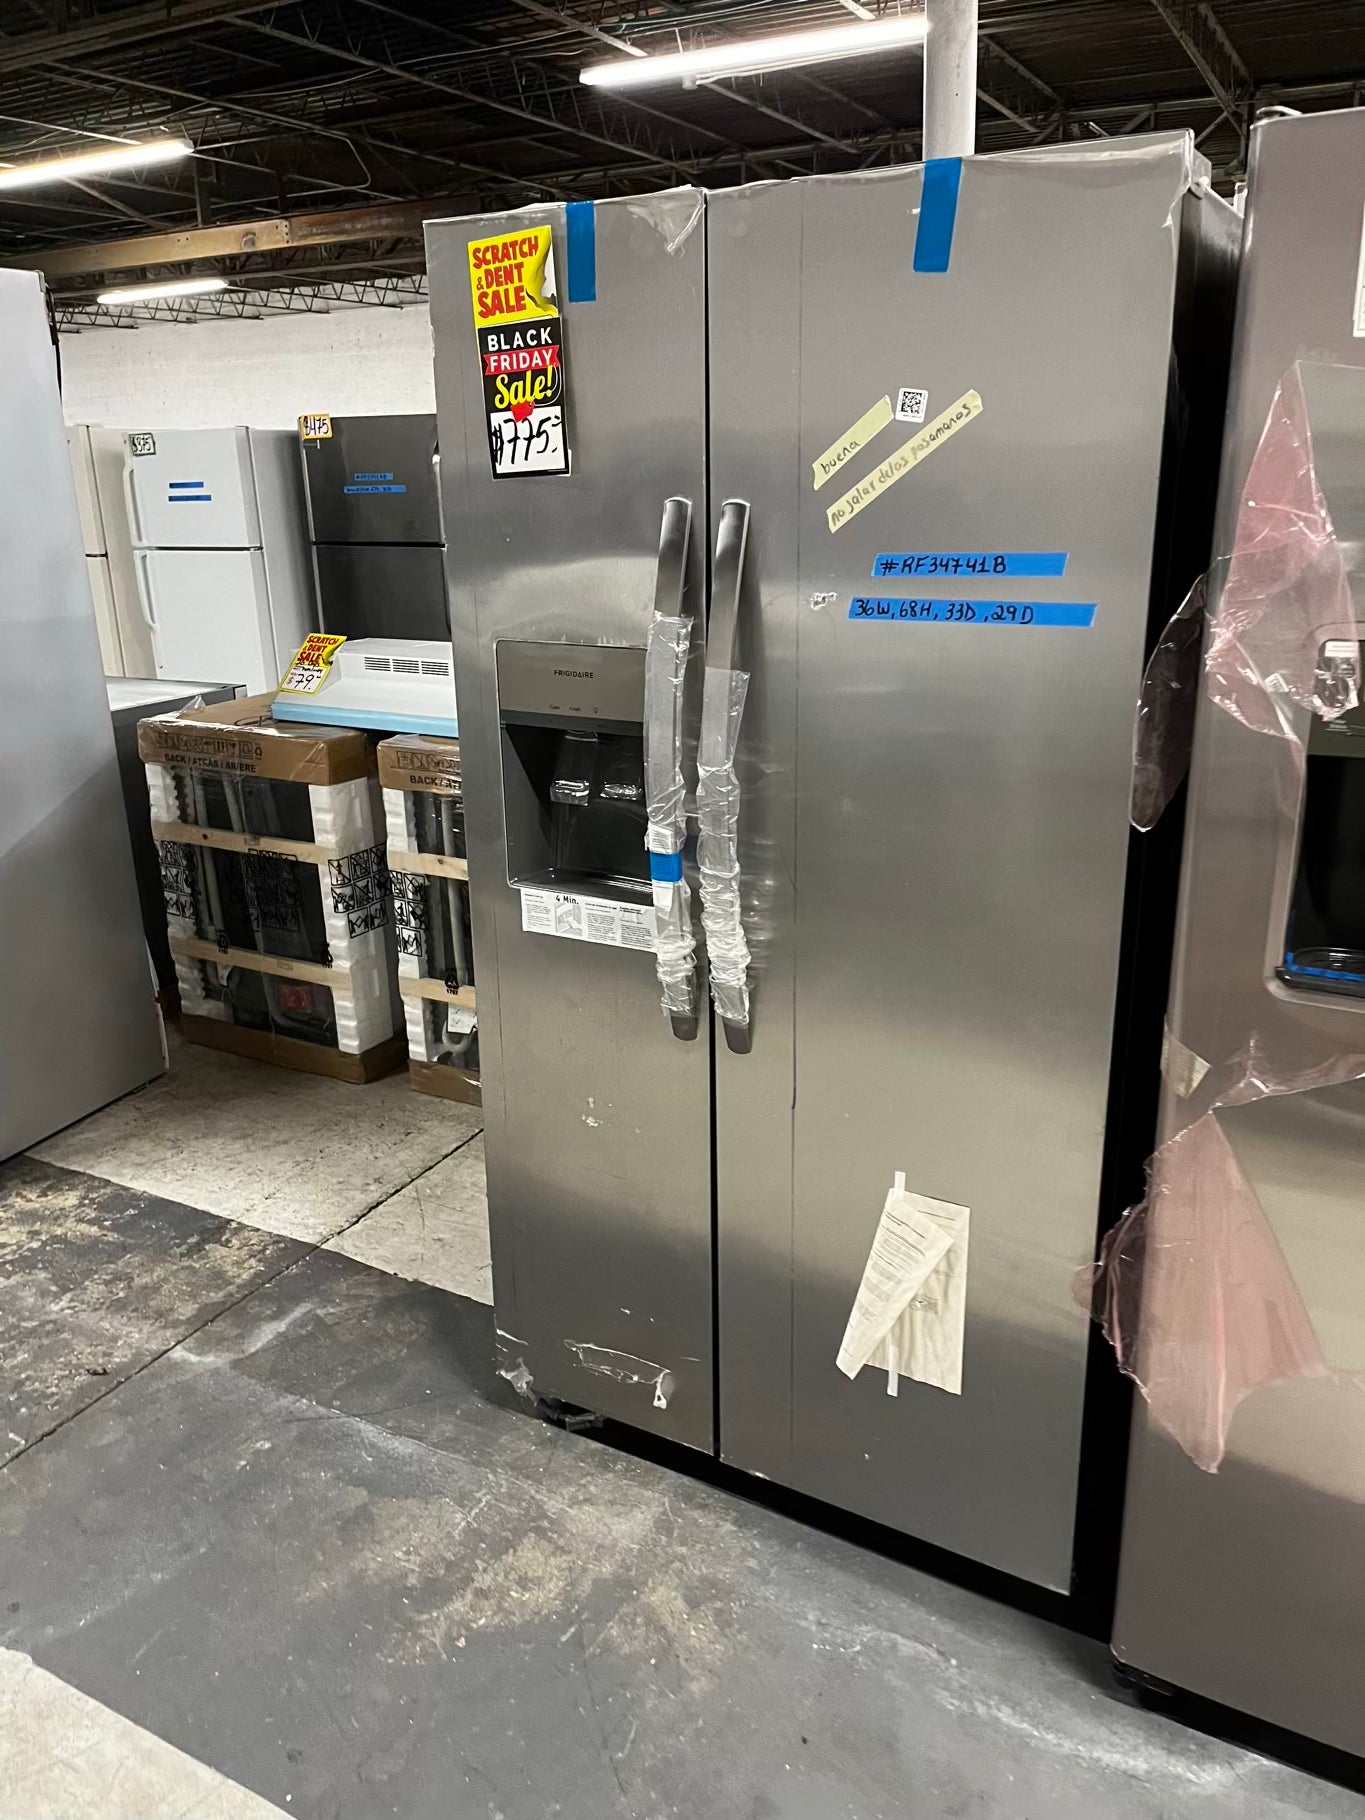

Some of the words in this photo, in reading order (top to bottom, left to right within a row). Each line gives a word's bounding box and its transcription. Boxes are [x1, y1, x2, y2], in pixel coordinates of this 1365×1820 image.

[472, 235, 539, 269] SCRATCH
[476, 276, 484, 291] &
[483, 261, 525, 290] DENT
[477, 284, 527, 319] SALE
[487, 326, 552, 352] BLACK
[489, 348, 553, 372] FRIDAY
[494, 364, 553, 409] Sale!
[303, 415, 329, 436] $475
[820, 440, 861, 475] buena
[831, 509, 846, 527] no
[307, 635, 339, 645] SCRATCH
[307, 644, 327, 652] DENT
[298, 652, 322, 662] SALE
[553, 669, 594, 679] FRIGIDAIRE
[164, 753, 187, 765] BACK
[409, 775, 439, 787] BACK
[563, 895, 580, 905] Min.
